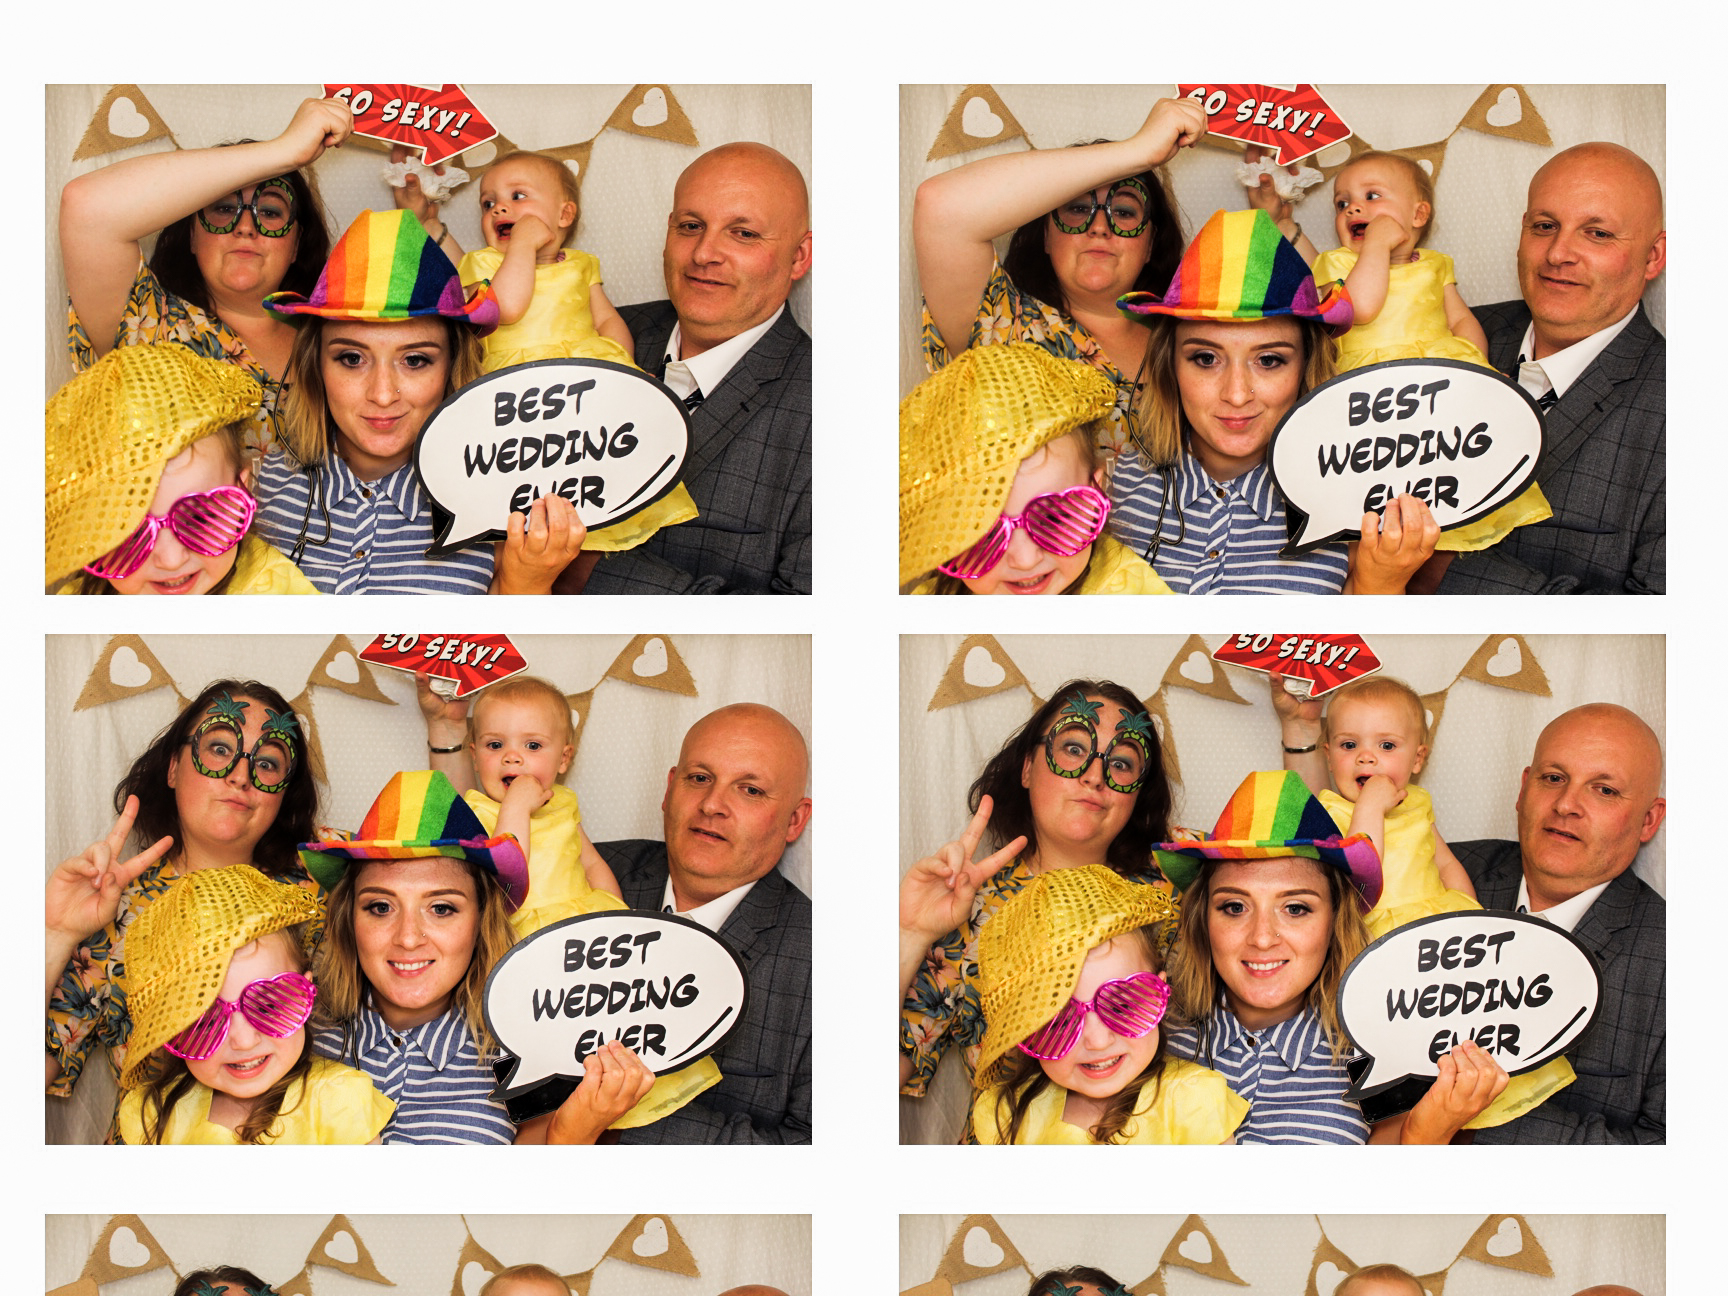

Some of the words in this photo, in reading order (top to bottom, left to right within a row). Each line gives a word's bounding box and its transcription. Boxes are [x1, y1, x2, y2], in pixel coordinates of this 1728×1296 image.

[381, 98, 472, 138] SEXY!
[1235, 98, 1326, 138] SEXY!
[495, 379, 596, 427] BEST
[1349, 379, 1450, 427] BEST
[464, 422, 639, 478] WEDDING
[1318, 422, 1493, 478] WEDDING
[423, 636, 506, 670] SEXY!
[1277, 636, 1360, 670] SEXY!
[564, 931, 661, 973] BEST
[1418, 931, 1515, 973] BEST
[532, 973, 699, 1022] WEDDING
[1386, 973, 1553, 1022] WEDDING
